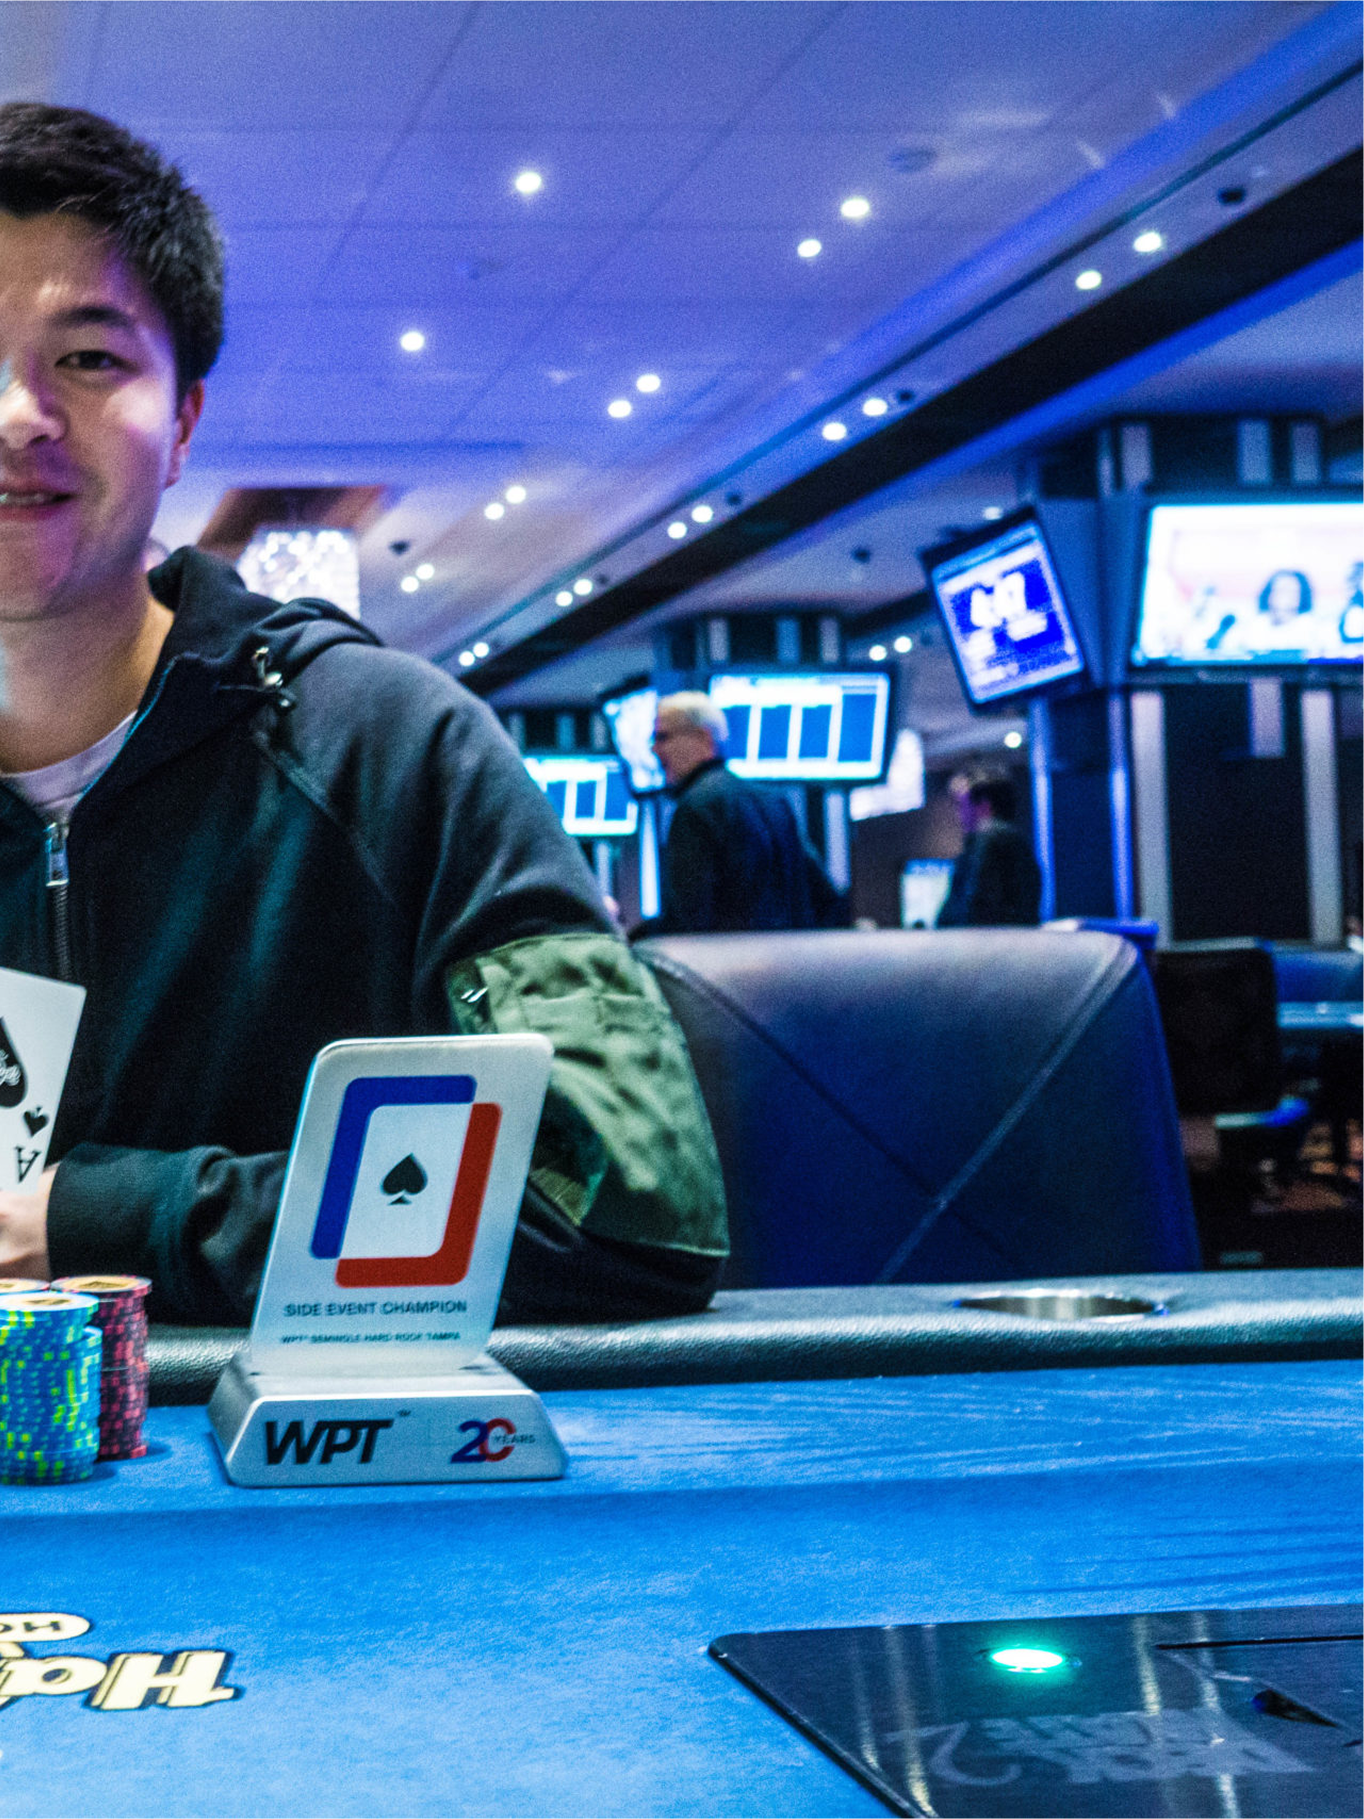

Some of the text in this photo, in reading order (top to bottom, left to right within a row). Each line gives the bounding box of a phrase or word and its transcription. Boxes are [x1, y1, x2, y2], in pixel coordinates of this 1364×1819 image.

[14, 1145, 41, 1183] A
[284, 1300, 467, 1317] SIDE EVENT CHAMPION
[426, 1332, 460, 1341] TAMPA
[264, 1418, 395, 1465] WPT
[494, 1434, 536, 1444] YEARS
